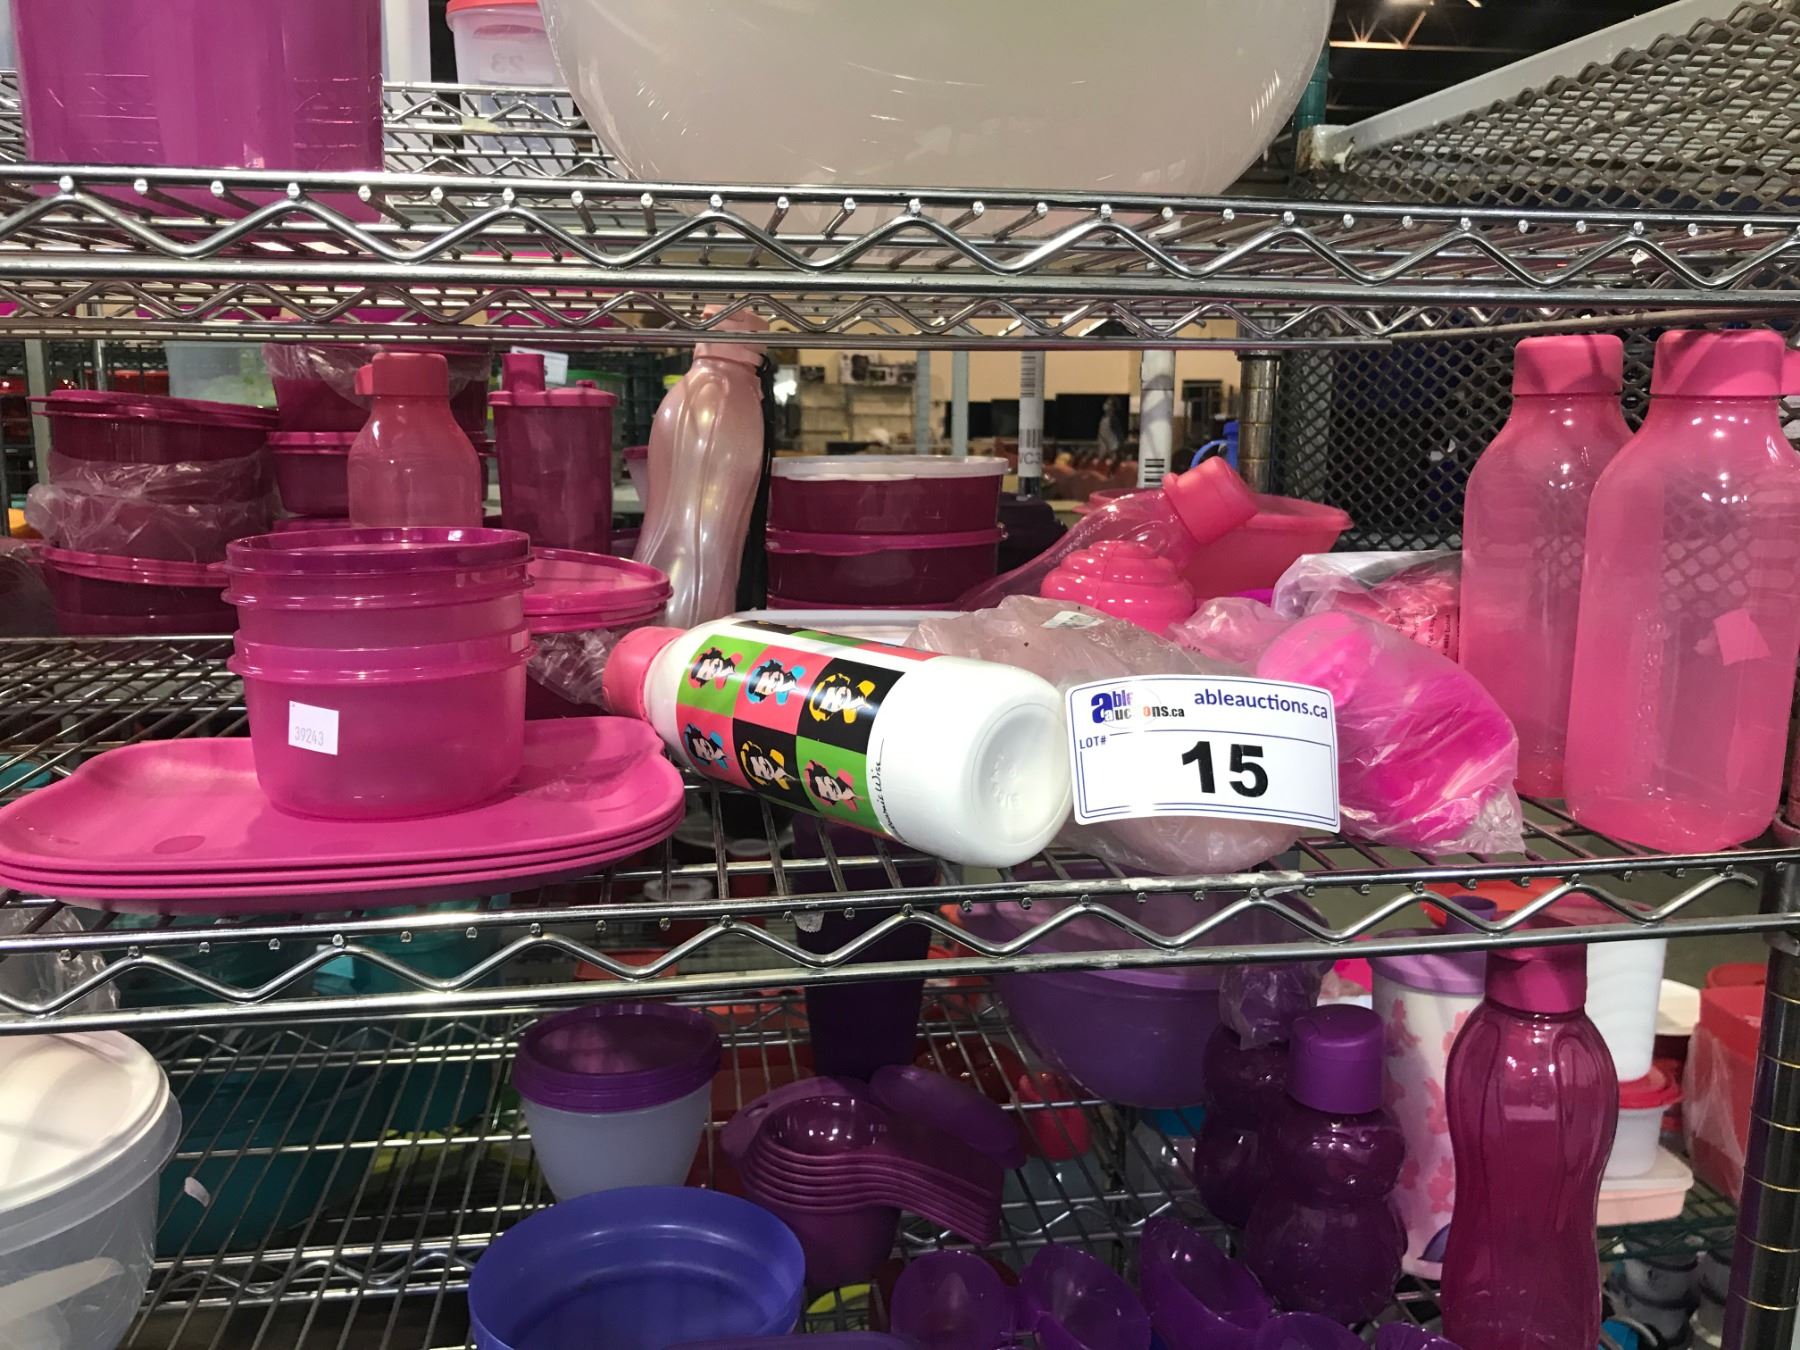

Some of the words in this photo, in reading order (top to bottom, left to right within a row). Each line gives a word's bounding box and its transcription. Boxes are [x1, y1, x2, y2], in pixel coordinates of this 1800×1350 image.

[1194, 688, 1328, 719] ableauctions.ca
[1103, 706, 1185, 722] aucons.ca
[294, 726, 324, 746] 39243
[1079, 735, 1106, 750] LOT#
[1181, 741, 1269, 798] 15
